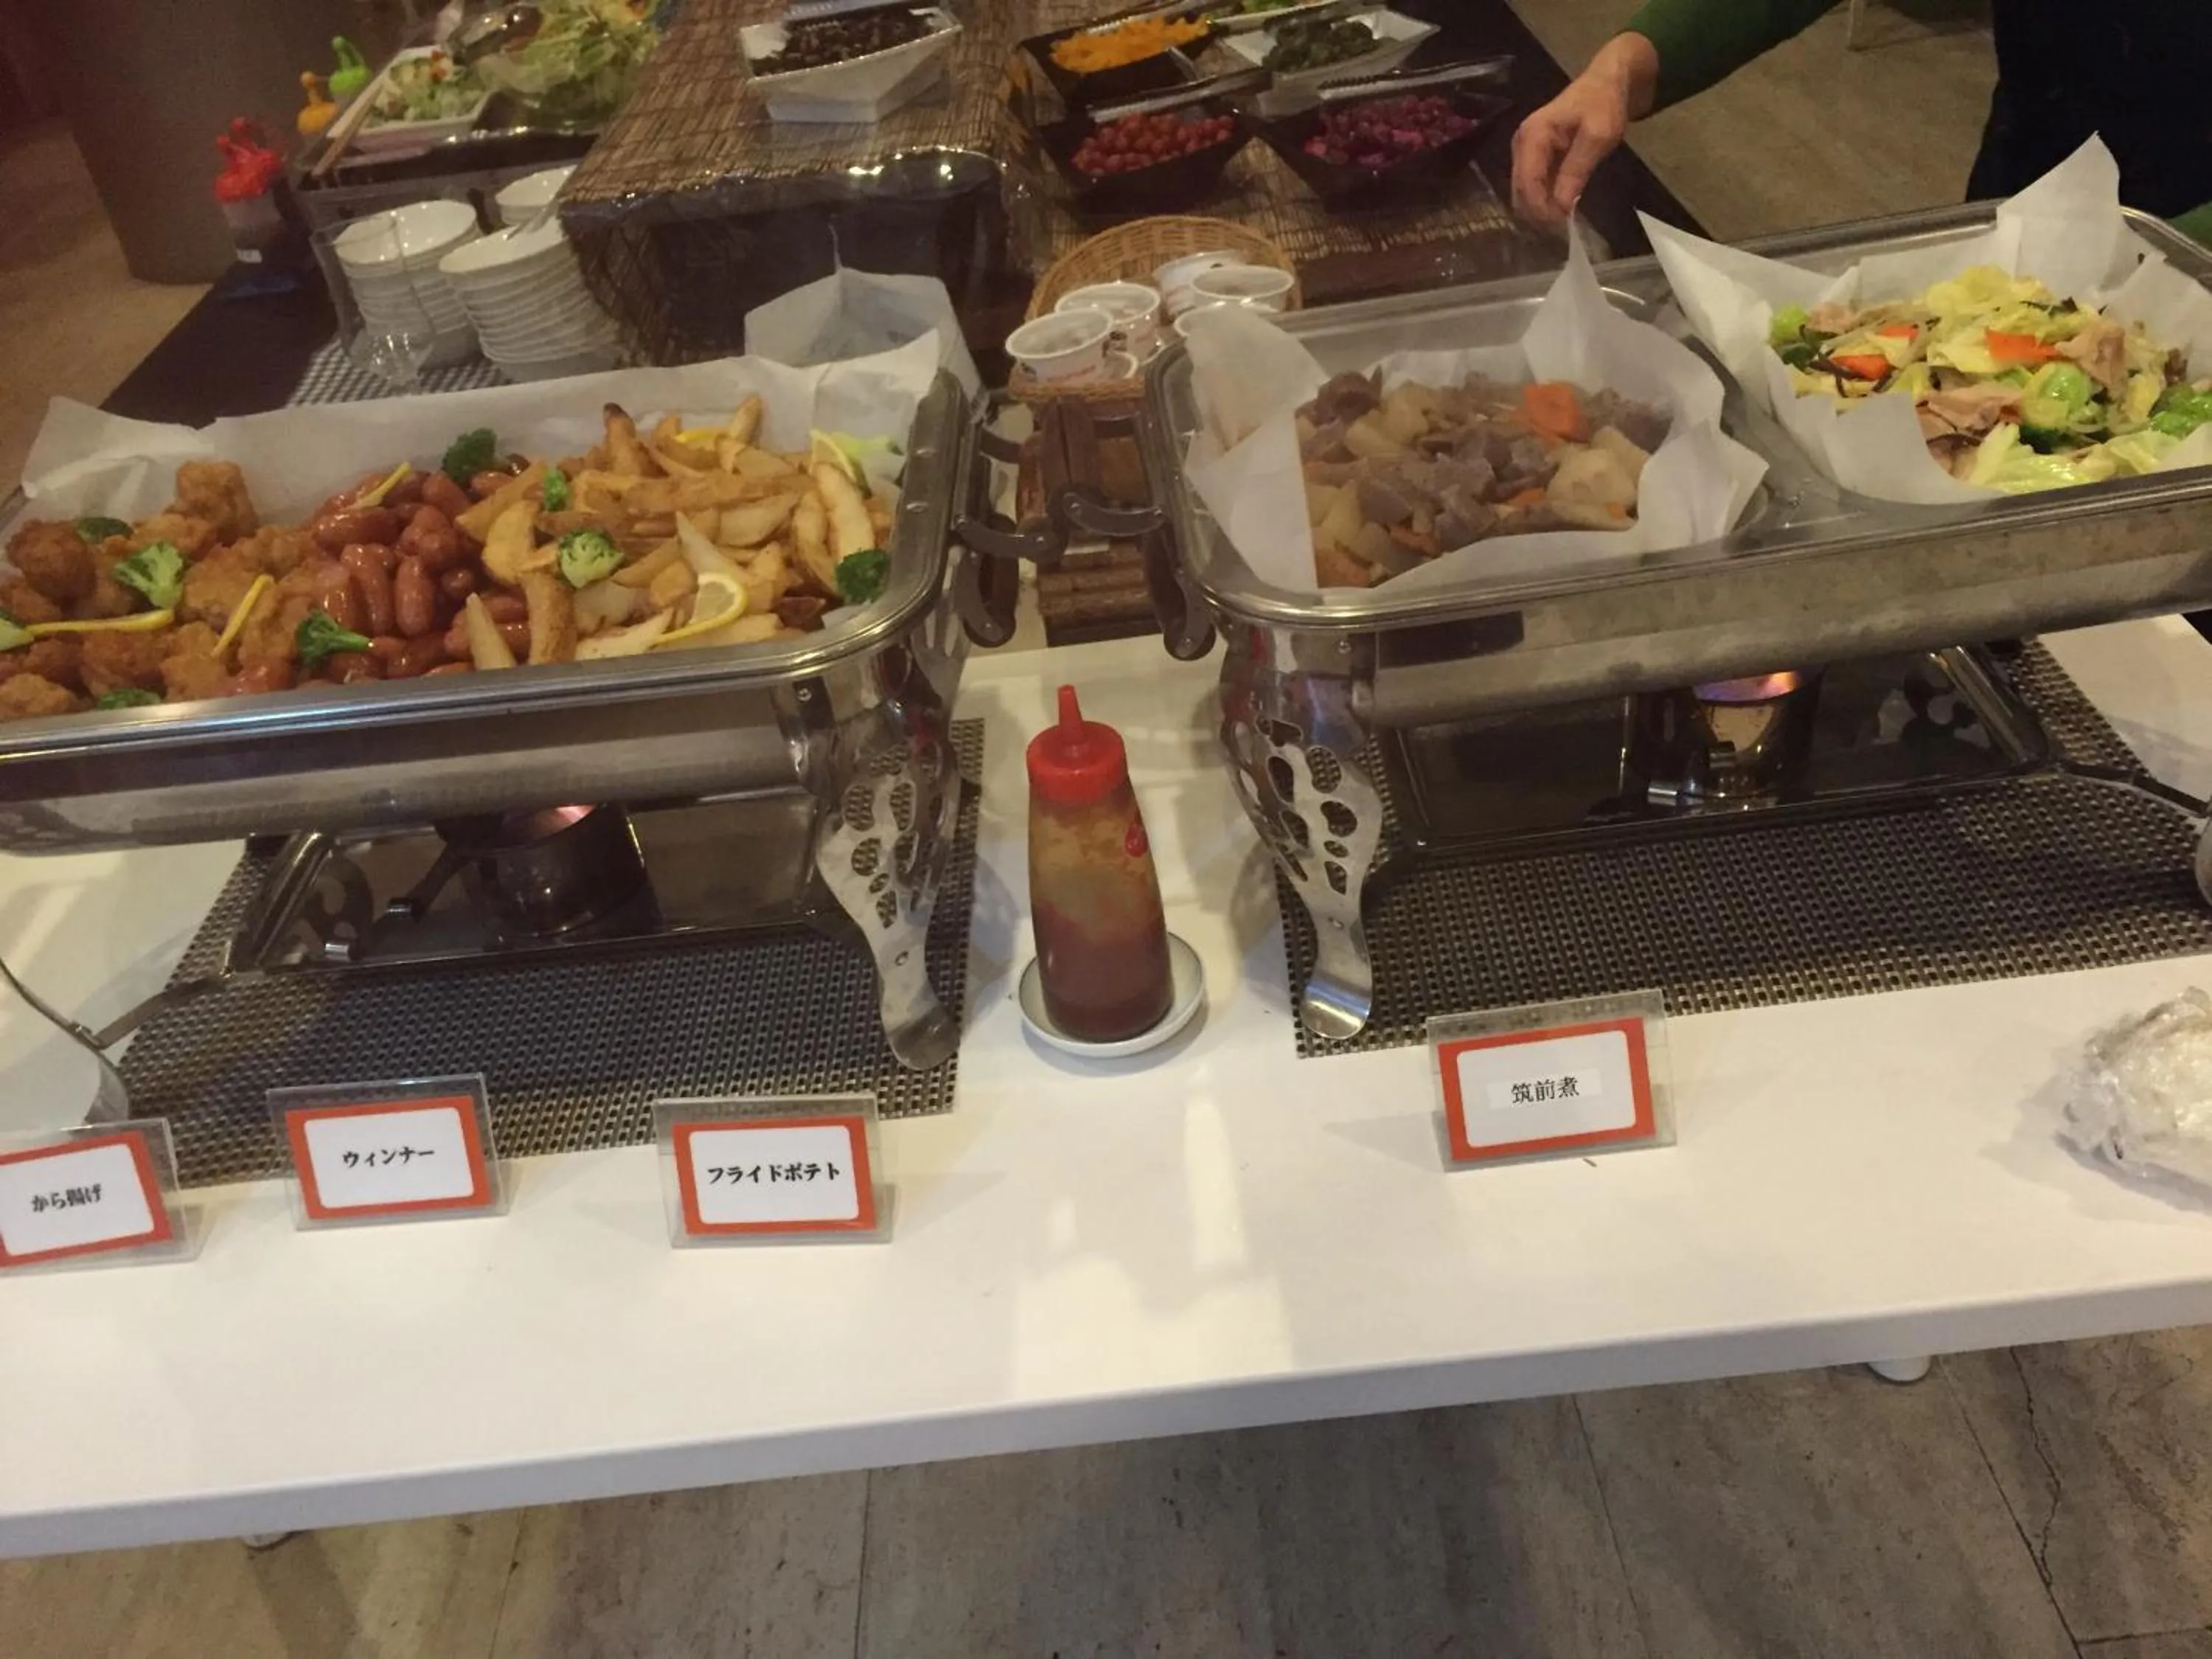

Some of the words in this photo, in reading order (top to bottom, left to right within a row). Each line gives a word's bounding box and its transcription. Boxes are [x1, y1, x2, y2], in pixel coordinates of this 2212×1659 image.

[1511, 1076, 1579, 1104] 筑前煮
[342, 1147, 437, 1169] ウィンナー
[707, 1163, 841, 1185] フライドポテト
[31, 1183, 102, 1213] から揚げ
